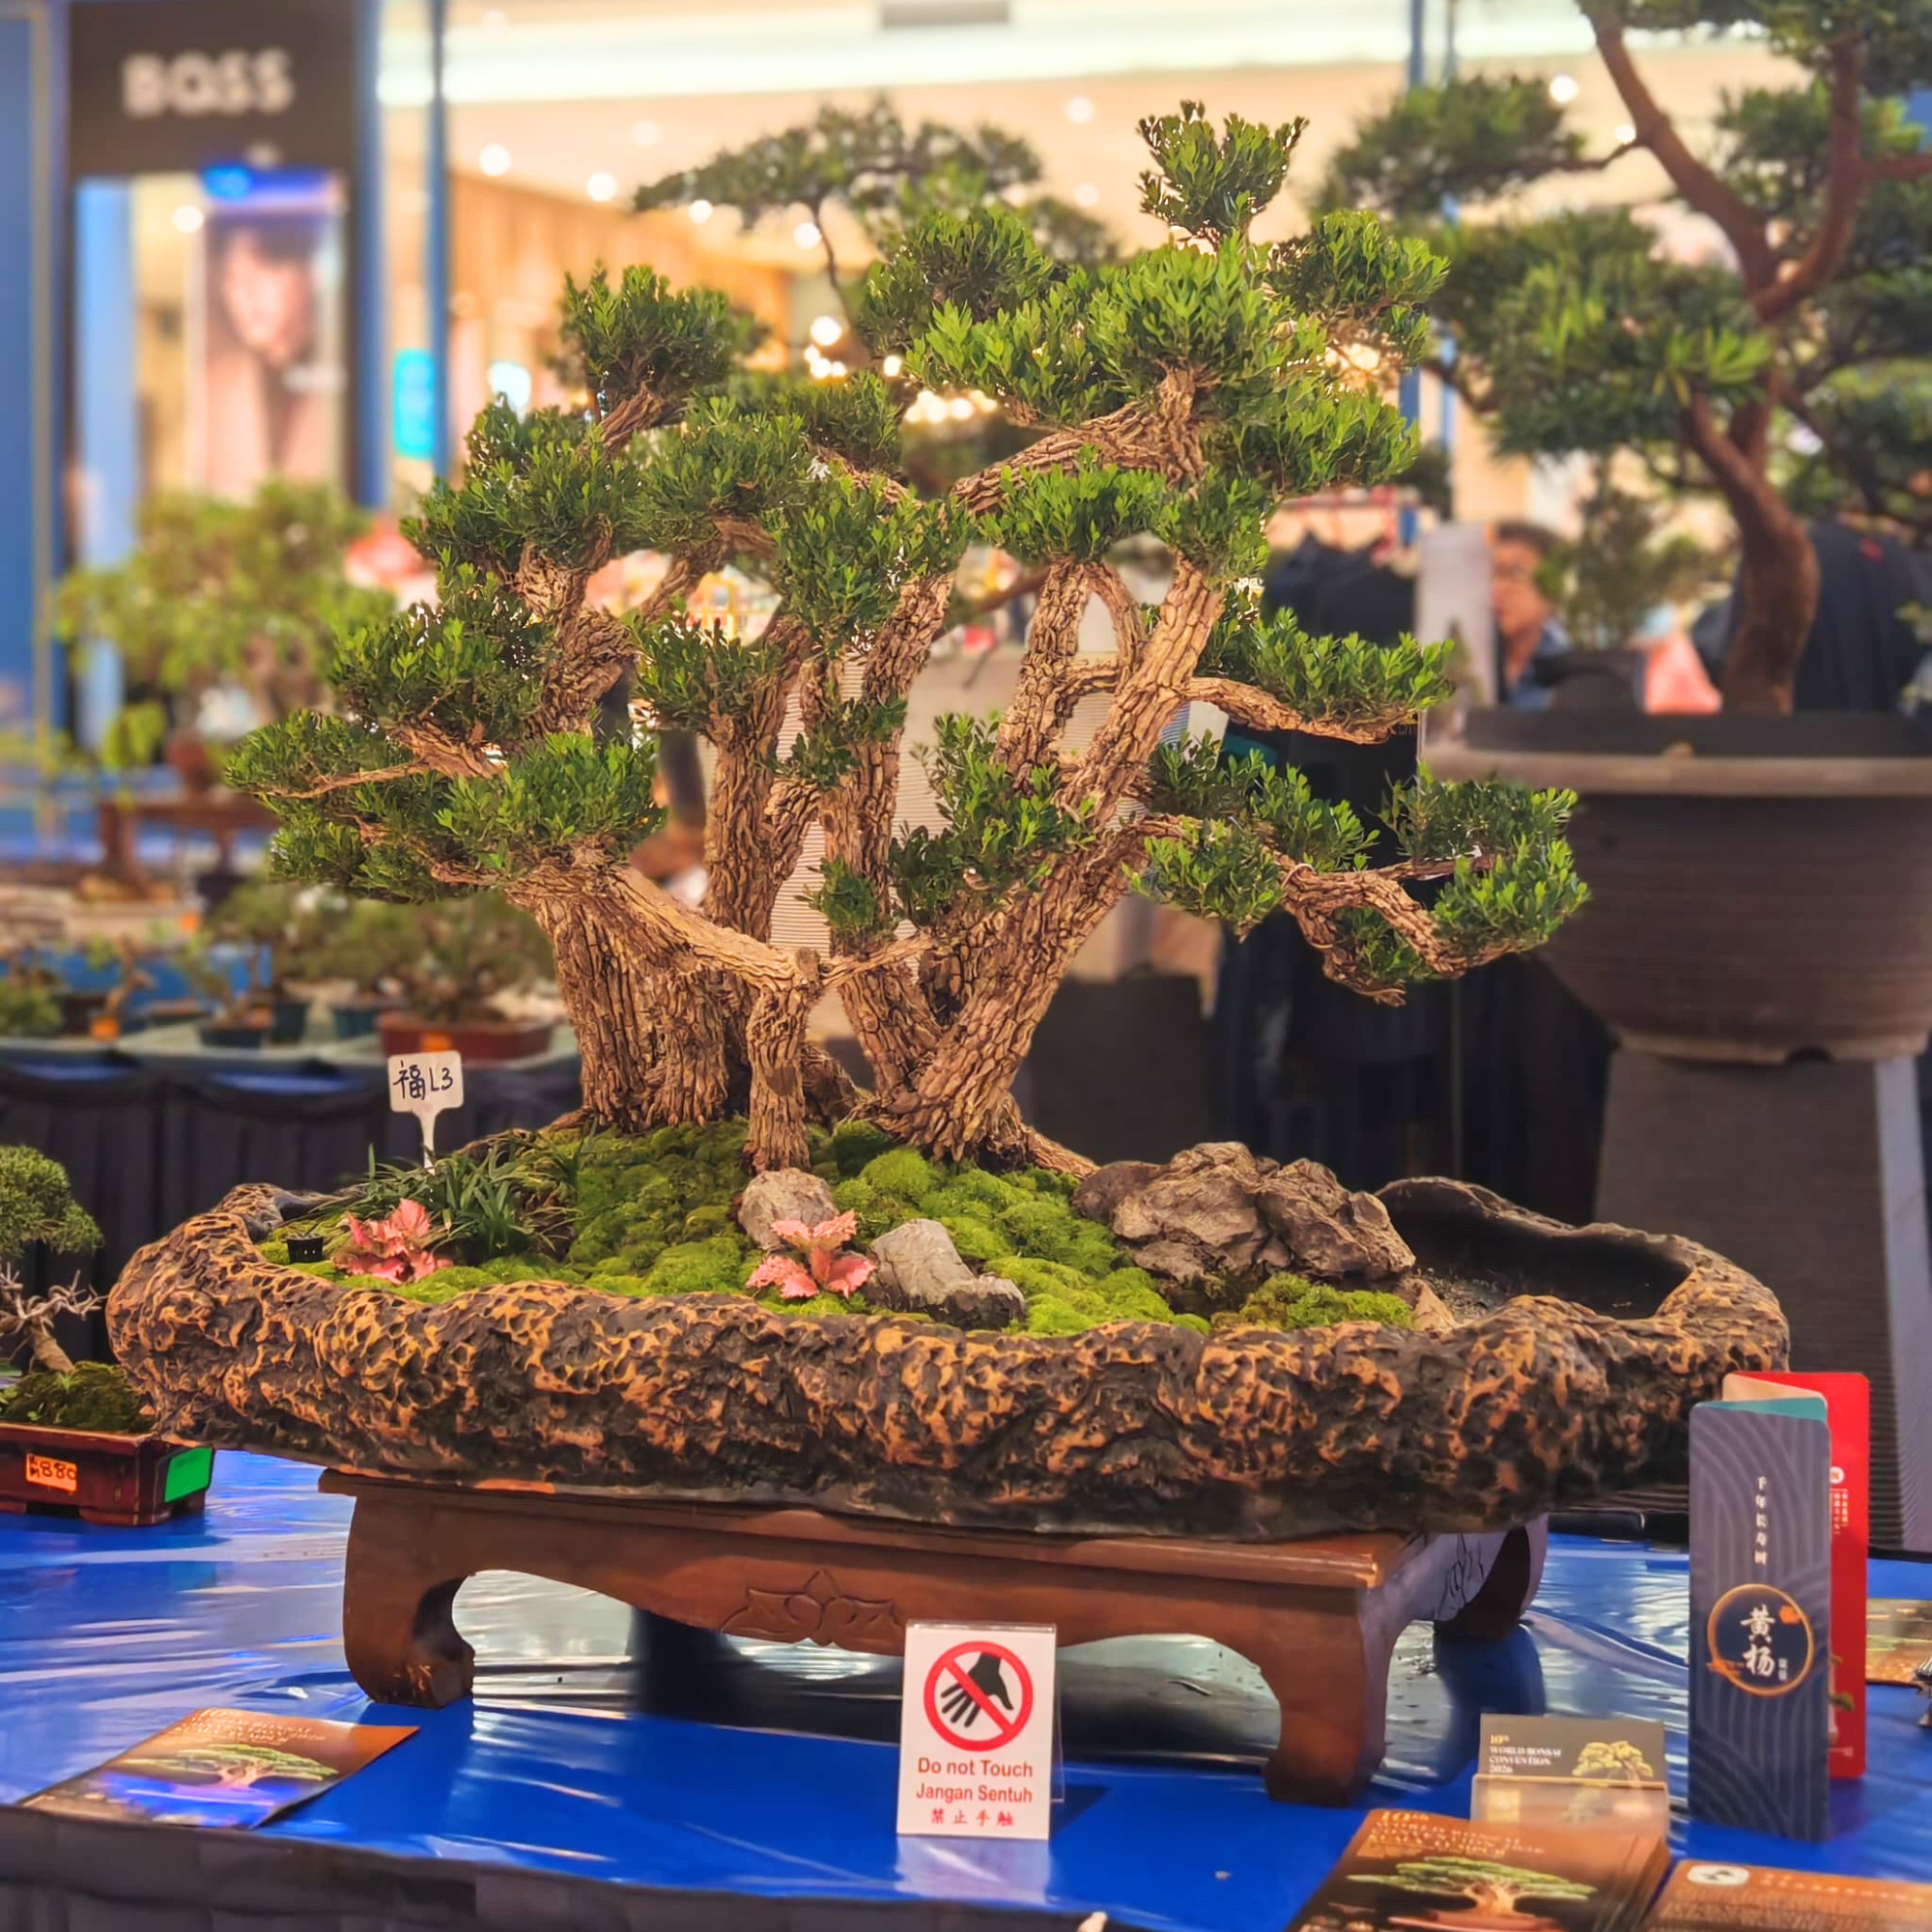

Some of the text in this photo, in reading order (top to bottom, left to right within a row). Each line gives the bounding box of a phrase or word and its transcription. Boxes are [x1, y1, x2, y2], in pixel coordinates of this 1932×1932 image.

[123, 49, 294, 118] BOSS
[918, 1757, 1033, 1777] Do not Touch
[917, 1782, 1033, 1804] Jangan Sentuh
